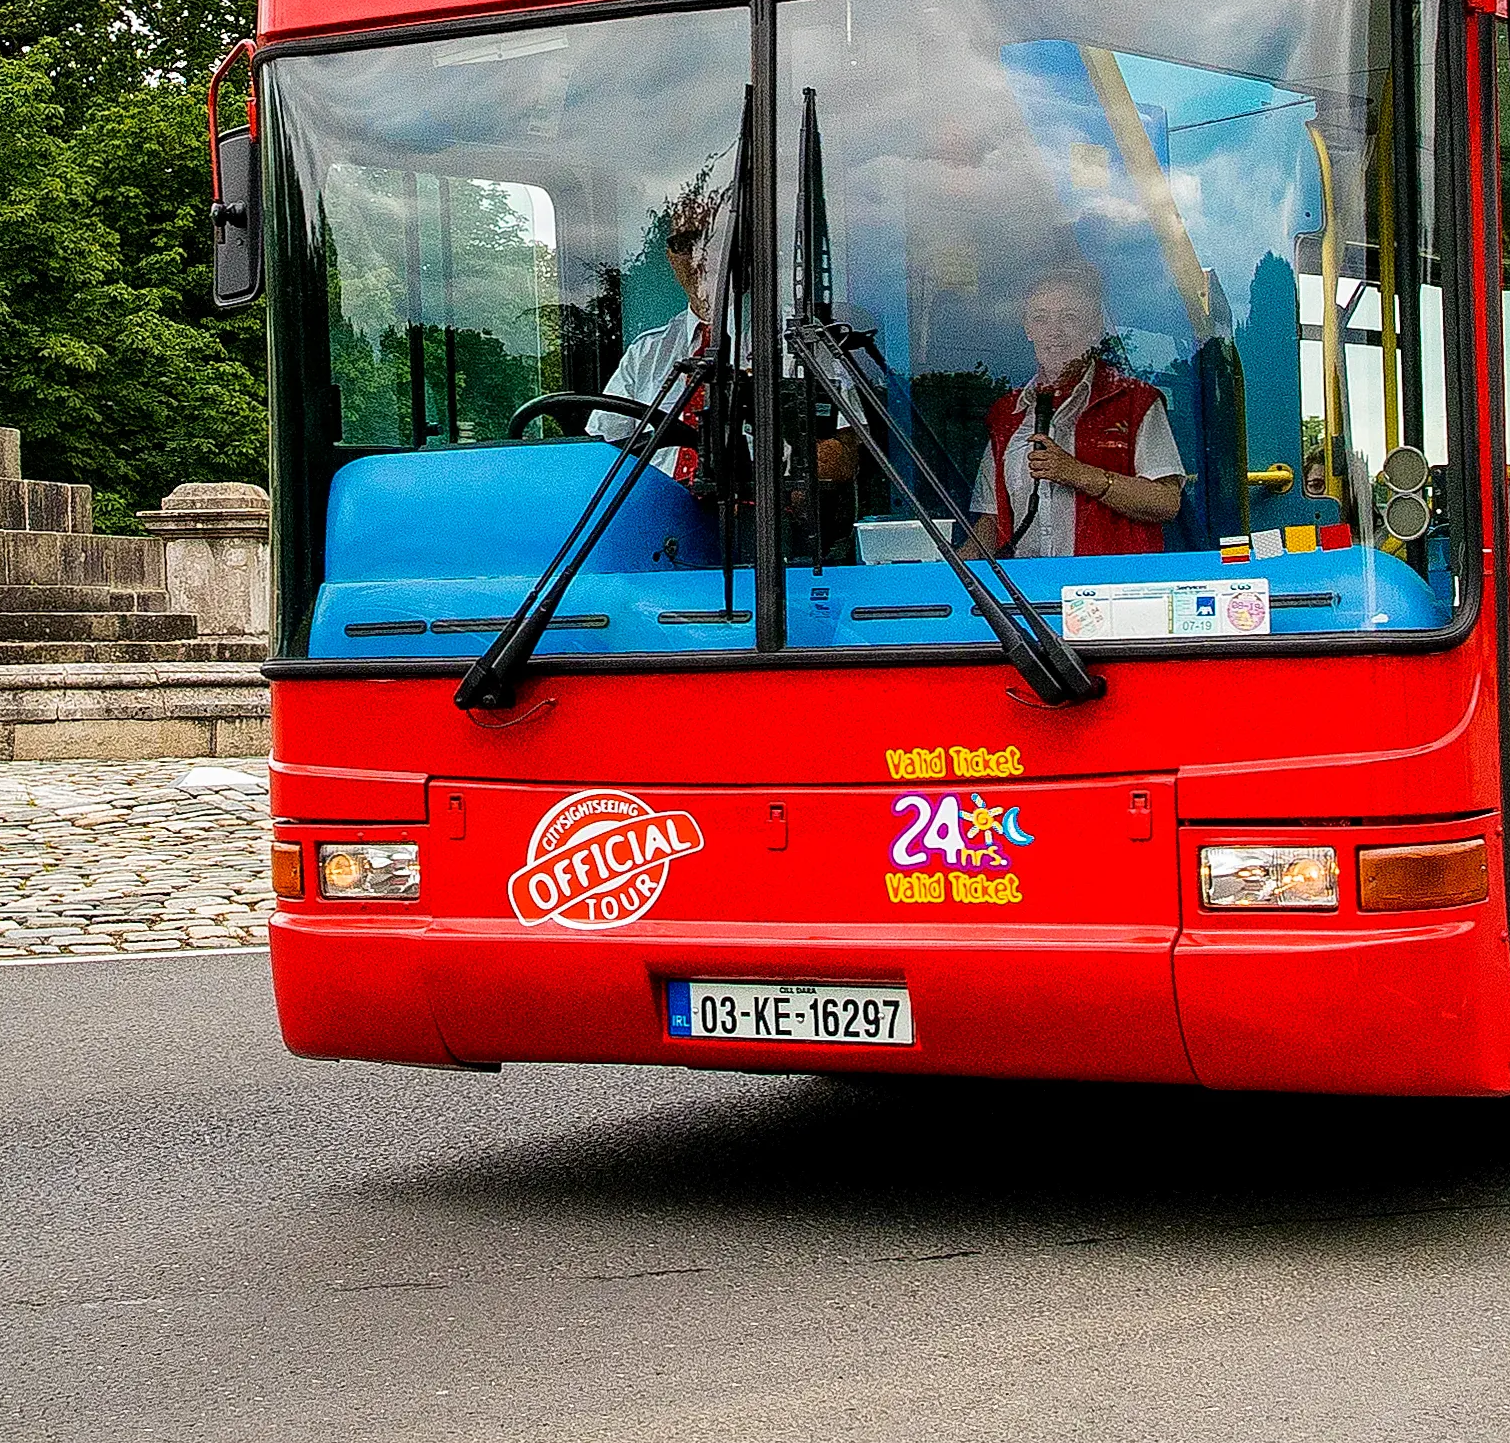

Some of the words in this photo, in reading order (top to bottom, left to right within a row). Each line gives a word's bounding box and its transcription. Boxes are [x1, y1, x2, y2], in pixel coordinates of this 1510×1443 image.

[1182, 620, 1212, 631] 07-19
[886, 747, 946, 779] Valid
[949, 746, 1025, 777] Ticket
[541, 799, 640, 851] CITYSIGHTSEEING
[528, 818, 692, 911] OFFICIAL
[585, 873, 658, 921] TOUR
[885, 873, 945, 903] Valid
[948, 871, 1023, 905] Ticket
[672, 1014, 690, 1027] IRL
[700, 995, 901, 1039] 03-KE-16297
